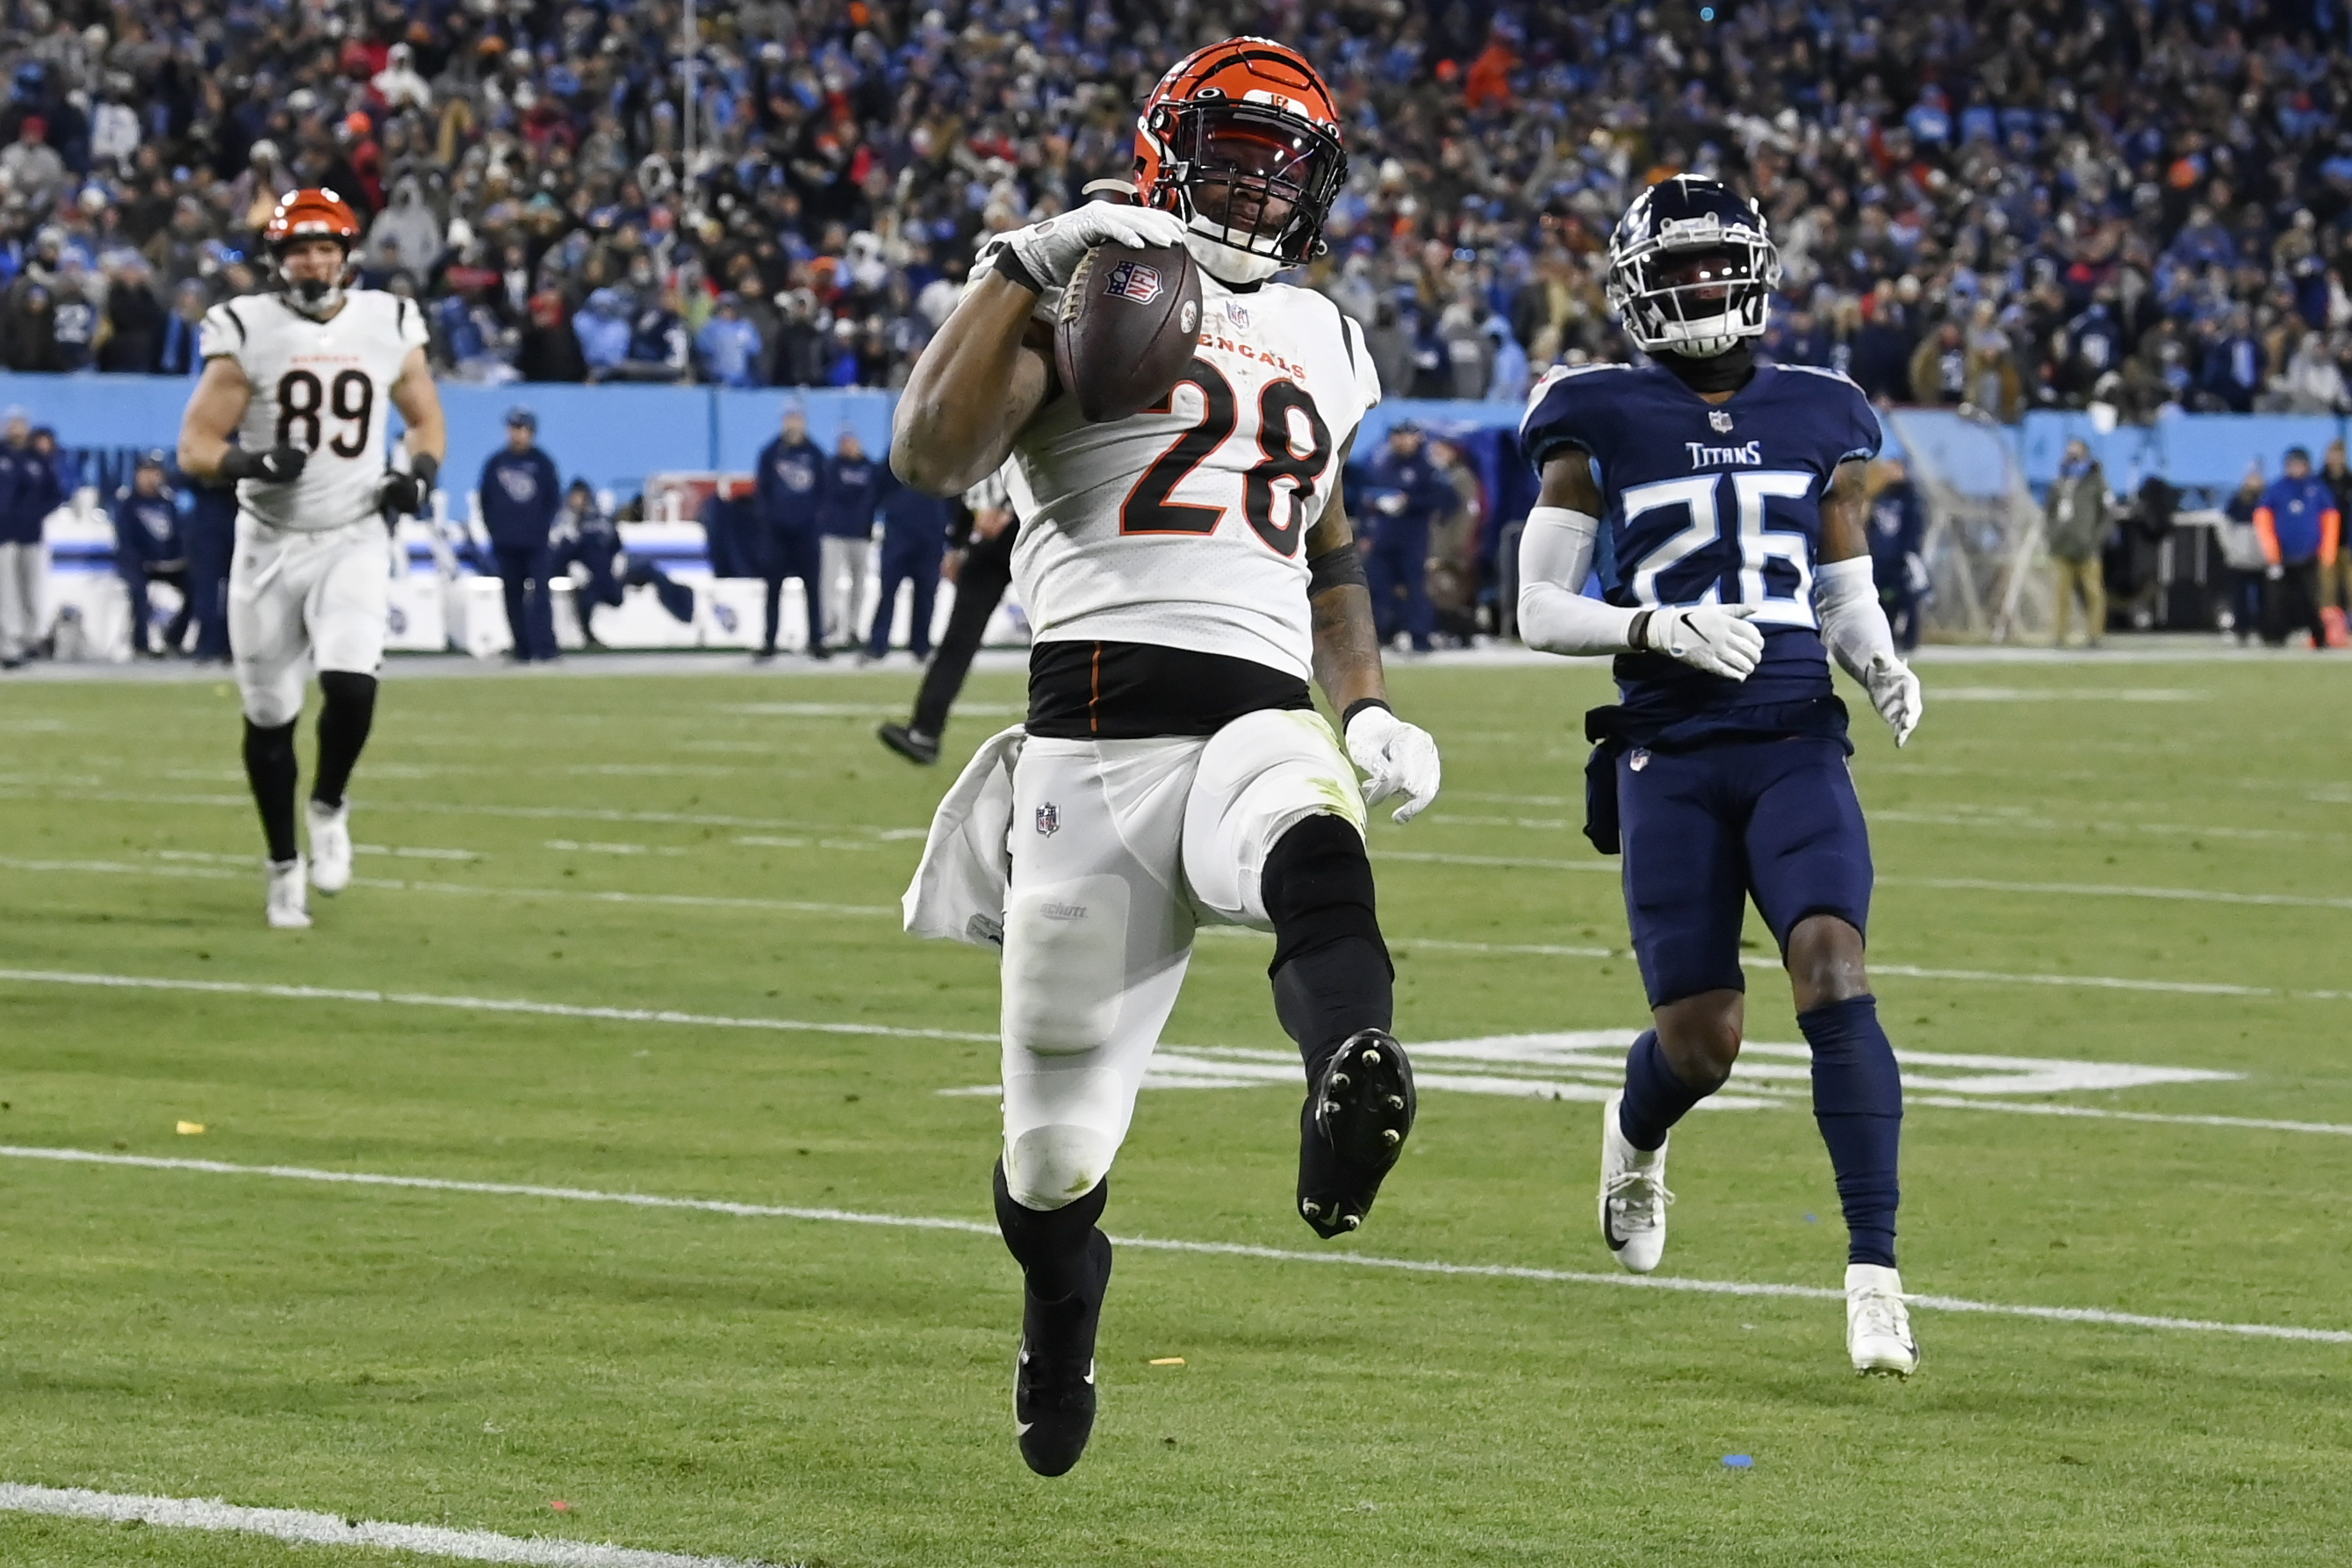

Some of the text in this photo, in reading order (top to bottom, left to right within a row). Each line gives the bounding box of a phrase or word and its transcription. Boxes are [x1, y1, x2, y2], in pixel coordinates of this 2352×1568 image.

[1126, 269, 1156, 299] NFL
[1198, 334, 1306, 380] ENGALS
[277, 369, 373, 459] 89
[1119, 355, 1333, 560] 28
[1620, 469, 1818, 630] 26
